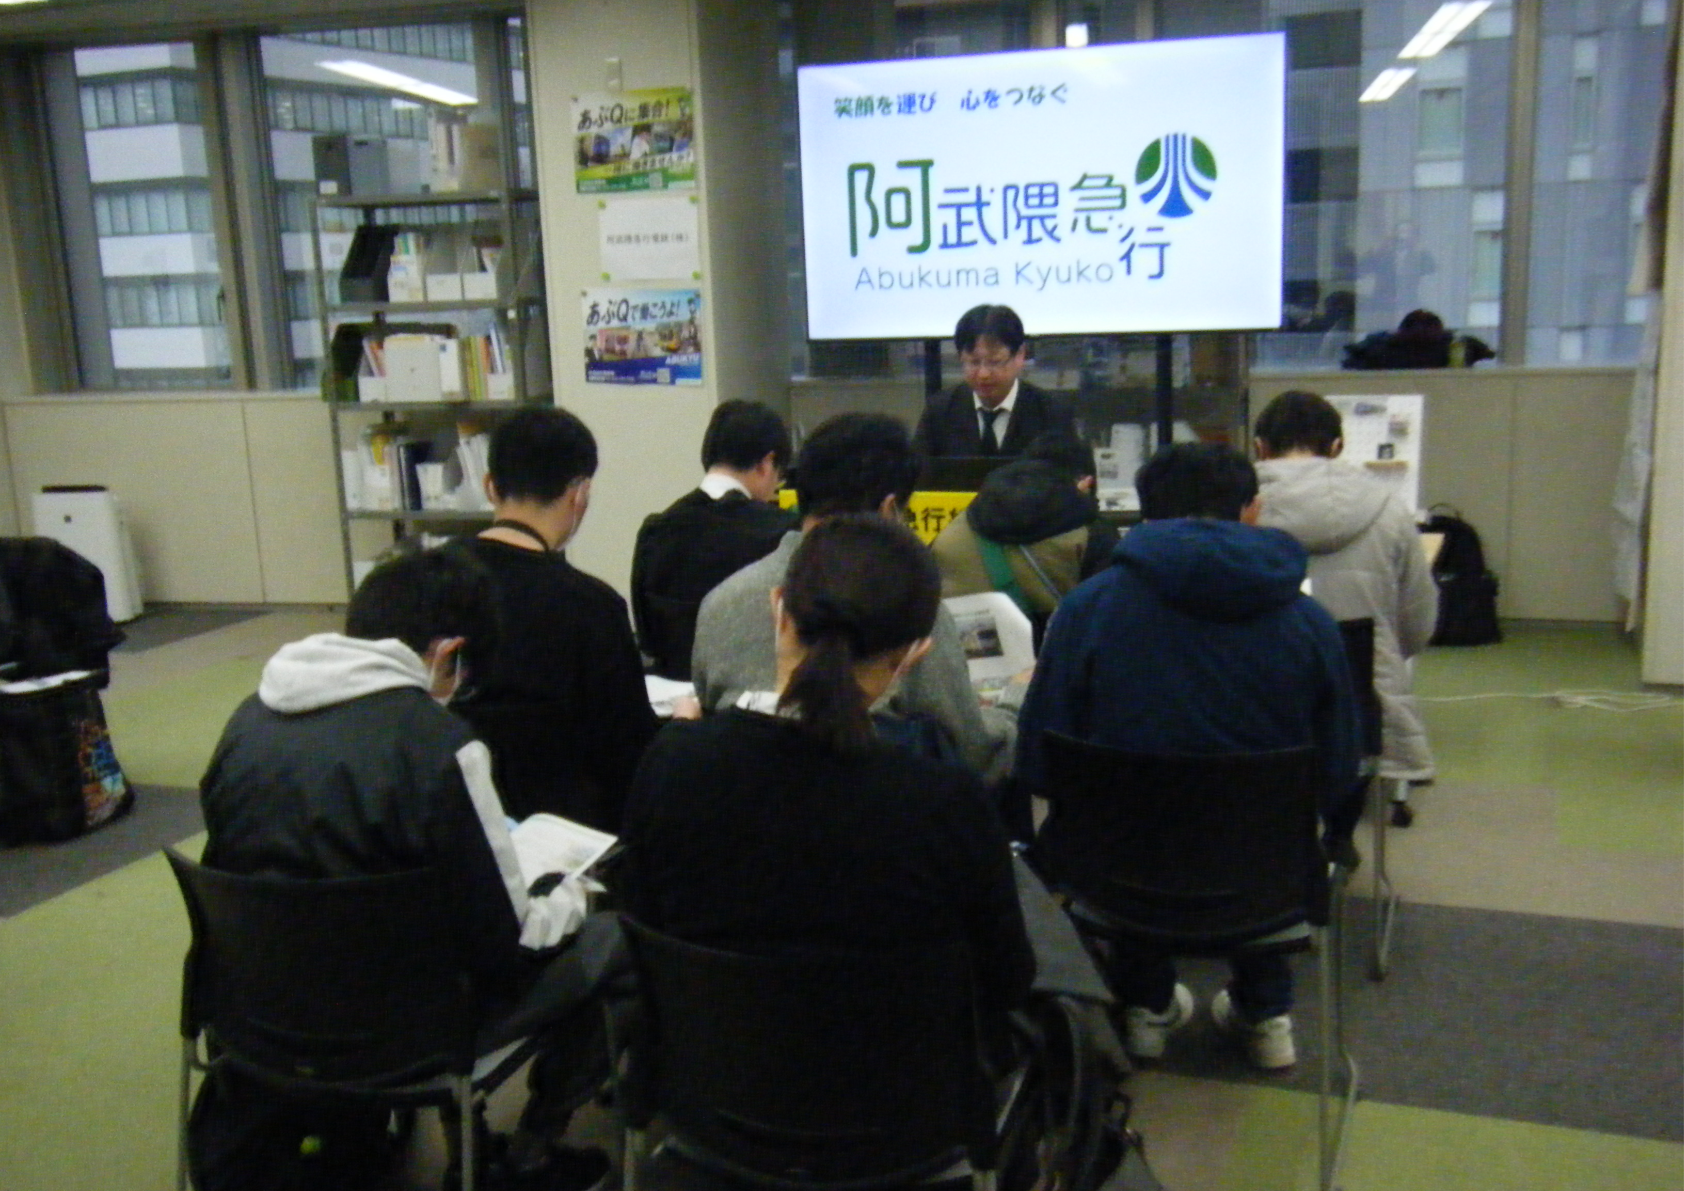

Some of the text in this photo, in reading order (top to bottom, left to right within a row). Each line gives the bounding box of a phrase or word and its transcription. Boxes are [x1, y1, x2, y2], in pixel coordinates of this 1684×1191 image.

[833, 82, 1069, 119] 笑顔を運び 心をつなぐ
[847, 158, 1172, 280] 阿武隈急行
[854, 258, 1114, 292] Abukuma Kyuko
